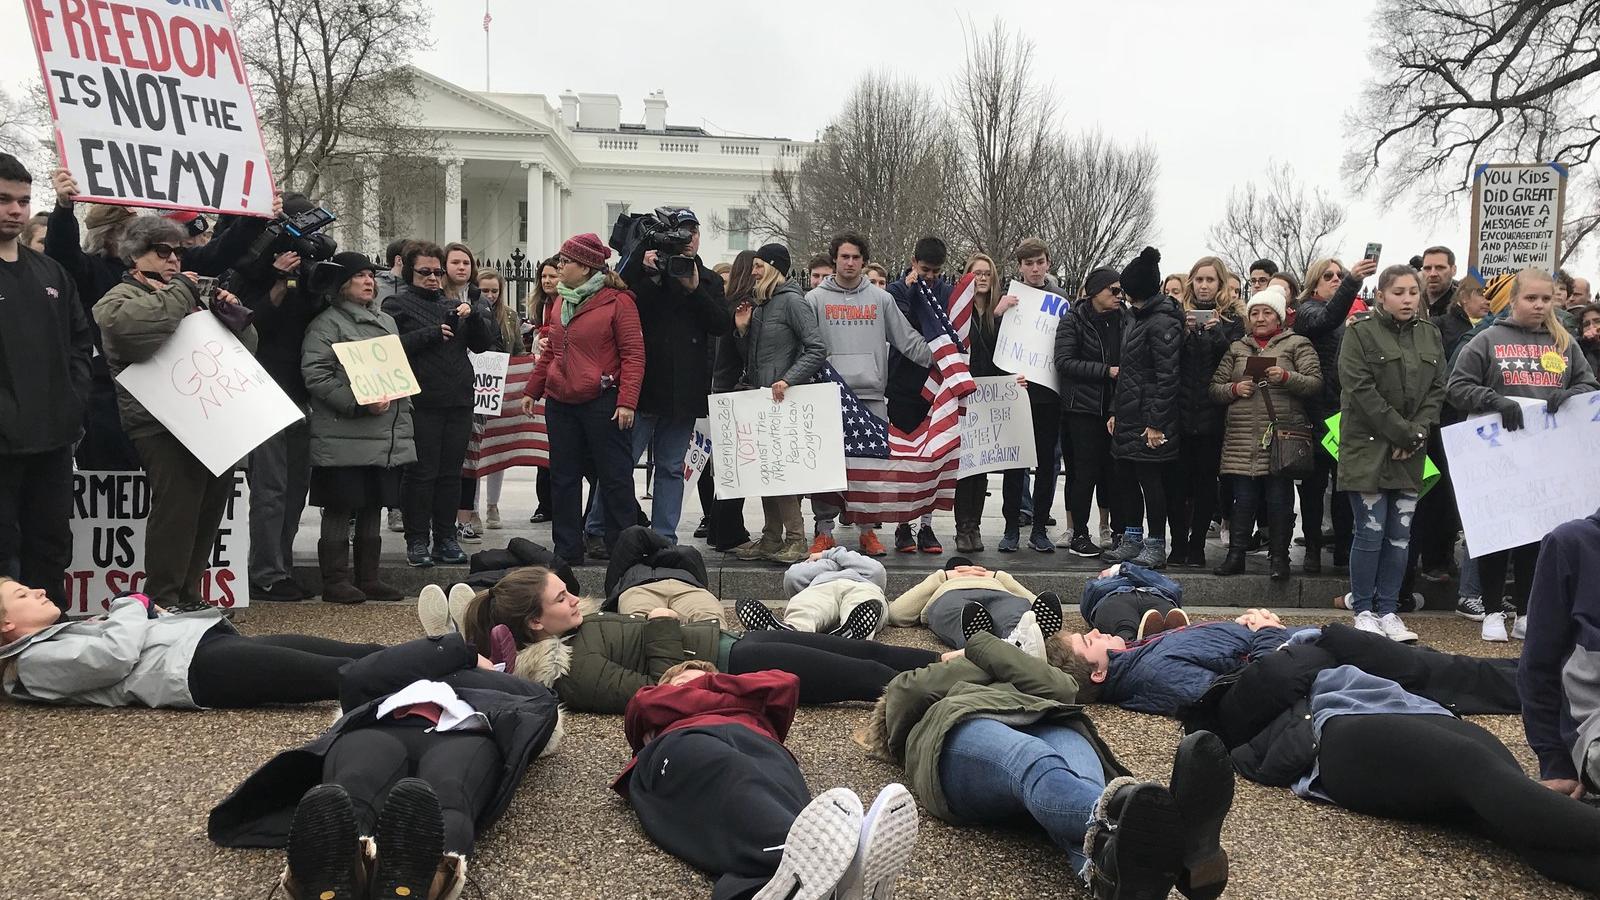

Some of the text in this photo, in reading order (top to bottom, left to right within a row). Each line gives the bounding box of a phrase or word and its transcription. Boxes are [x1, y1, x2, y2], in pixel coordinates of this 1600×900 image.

[30, 0, 244, 85] FREEDOM
[51, 66, 243, 136] IS NOT THE
[1483, 170, 1512, 186] YOU
[1513, 188, 1557, 202] GREAT
[1483, 204, 1550, 218] YOU GAVE A
[1481, 219, 1529, 230] MESSAGE
[1481, 242, 1501, 251] AND
[1513, 253, 1528, 263] WE
[1480, 266, 1501, 276] HAVE
[825, 304, 877, 320] POTOMAC
[171, 340, 223, 396] GOP
[354, 368, 411, 397] GUNS
[474, 373, 503, 388] NOT
[1503, 370, 1563, 387] BASEBALL
[736, 422, 757, 467] VOTE
[756, 439, 774, 486] against
[71, 474, 150, 519] RMED
[92, 526, 135, 568] US
